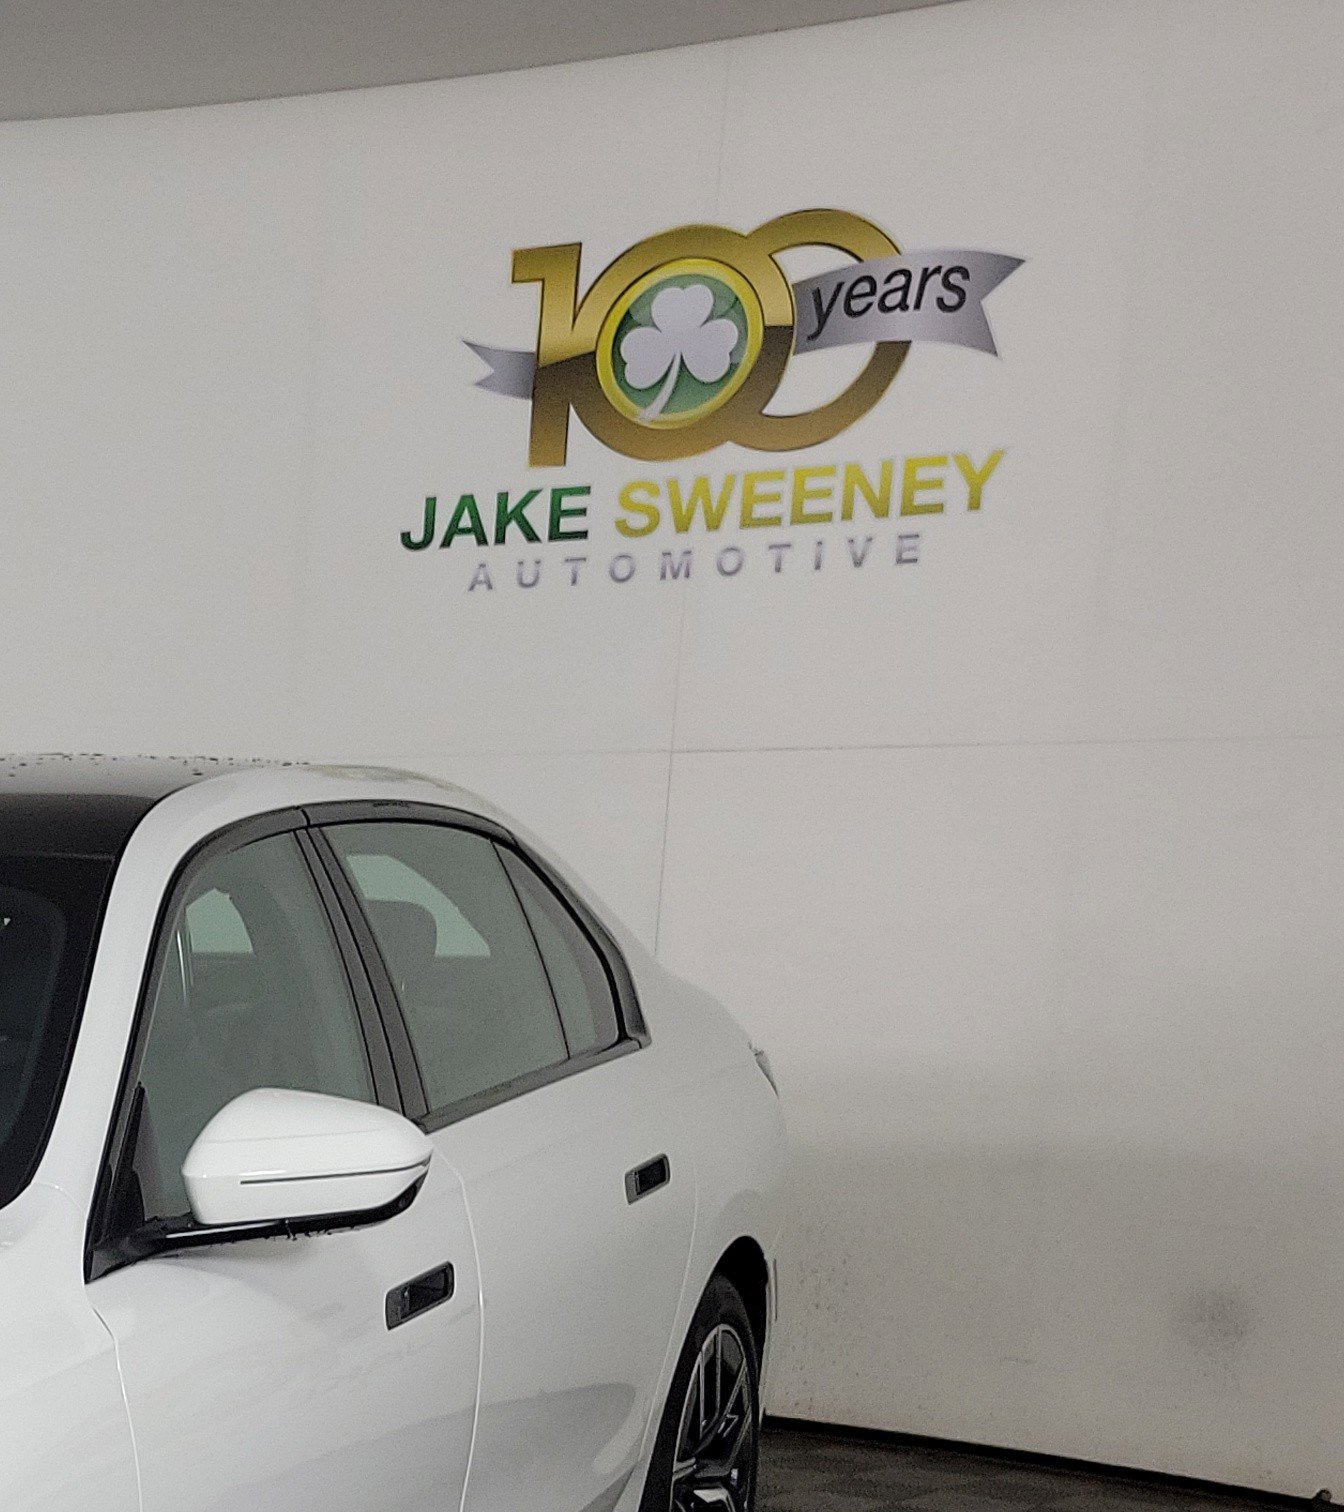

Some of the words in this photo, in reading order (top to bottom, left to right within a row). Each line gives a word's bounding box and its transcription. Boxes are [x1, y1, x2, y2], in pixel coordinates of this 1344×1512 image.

[511, 208, 910, 468] 100
[806, 261, 970, 341] years
[399, 485, 592, 552] JAKE
[613, 449, 1006, 539] SWEENEY
[467, 533, 922, 593] AUTOMOTIVE
